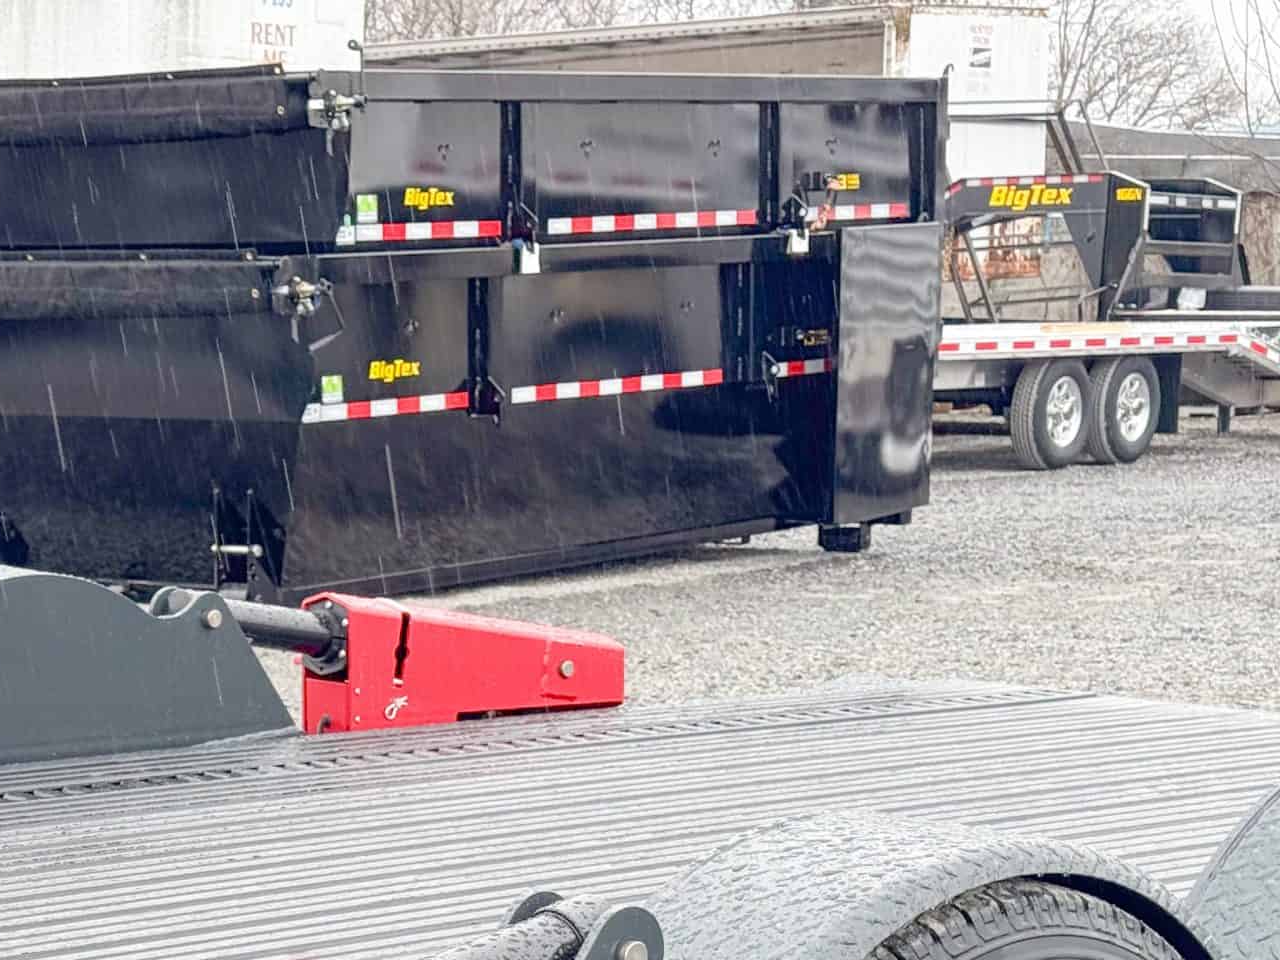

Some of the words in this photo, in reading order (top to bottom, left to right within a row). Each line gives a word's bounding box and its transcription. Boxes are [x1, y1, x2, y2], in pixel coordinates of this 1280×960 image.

[250, 22, 296, 47] RENT
[404, 187, 454, 210] BigTex
[989, 184, 1072, 210] BigTex
[368, 359, 420, 383] BigTex
